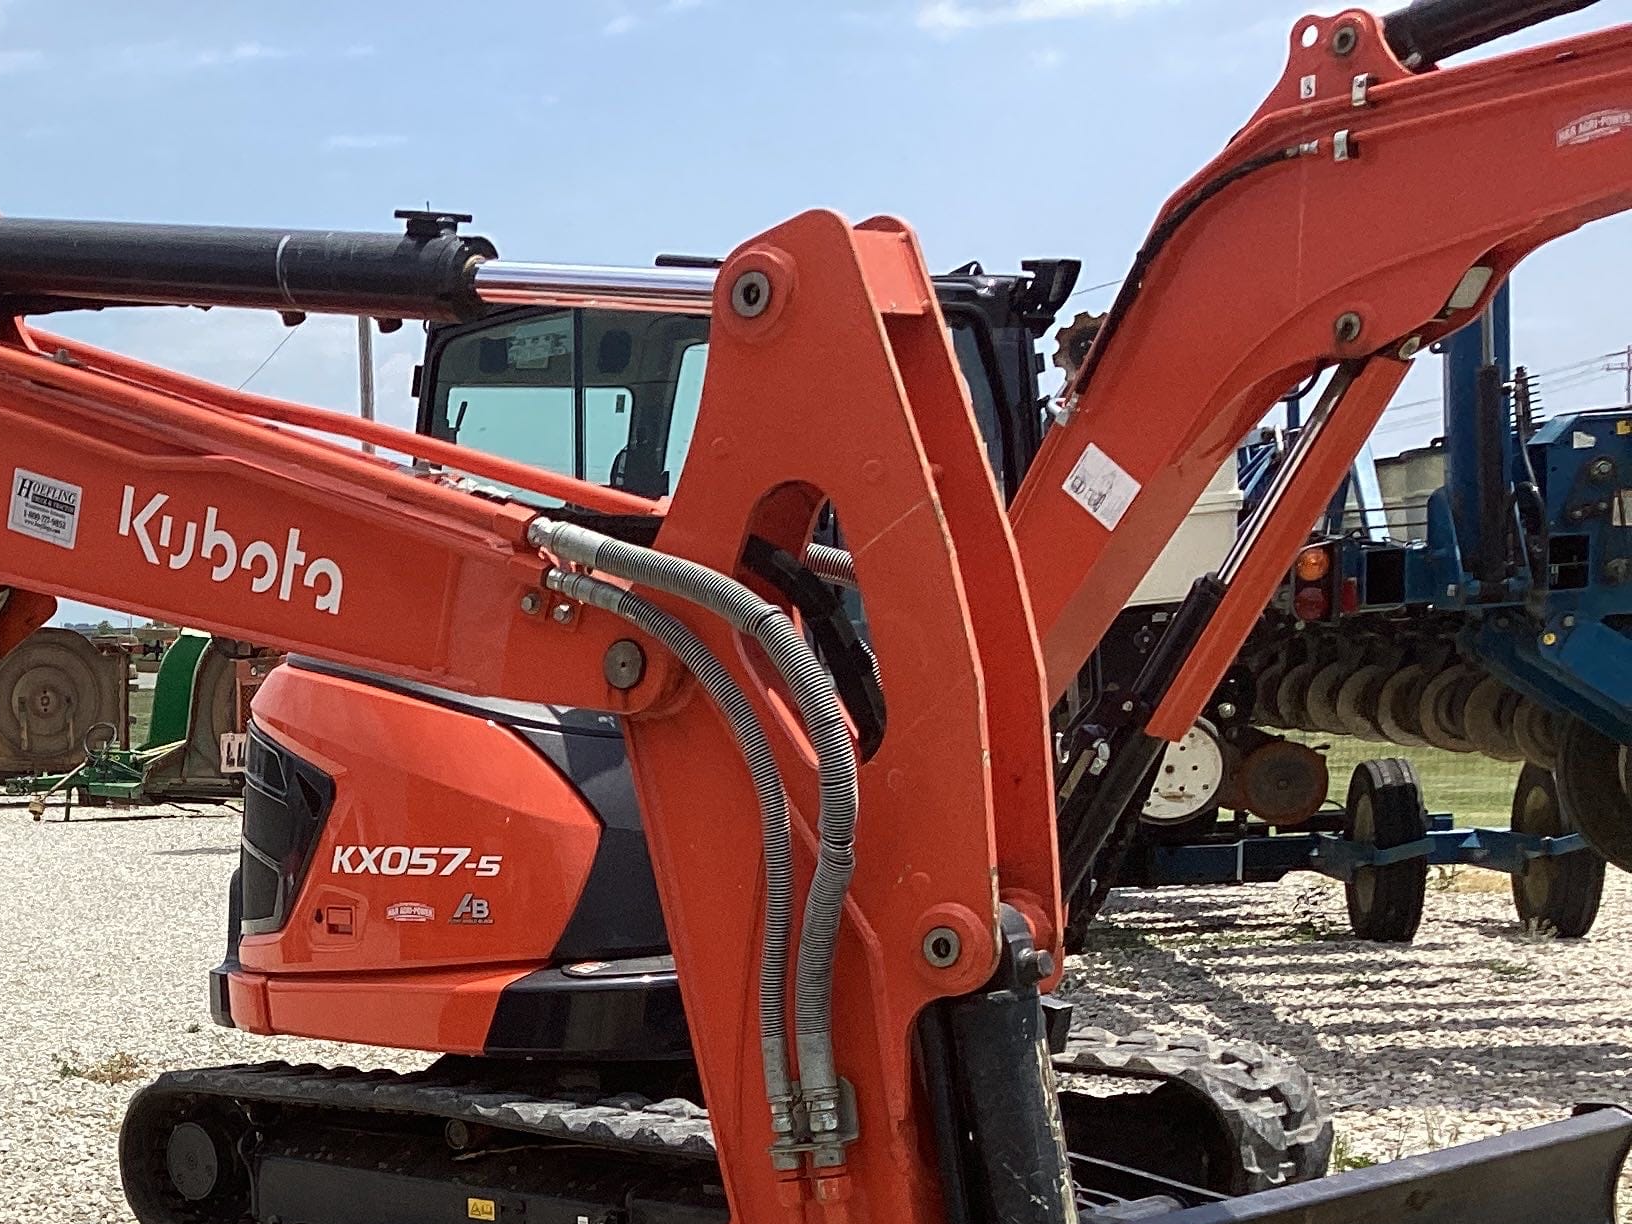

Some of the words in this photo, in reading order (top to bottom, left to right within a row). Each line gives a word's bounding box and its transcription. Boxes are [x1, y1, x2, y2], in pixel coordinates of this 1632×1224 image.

[16, 477, 77, 505] HOEFLING
[118, 484, 344, 615] Kubota
[331, 845, 503, 877] KX057-5
